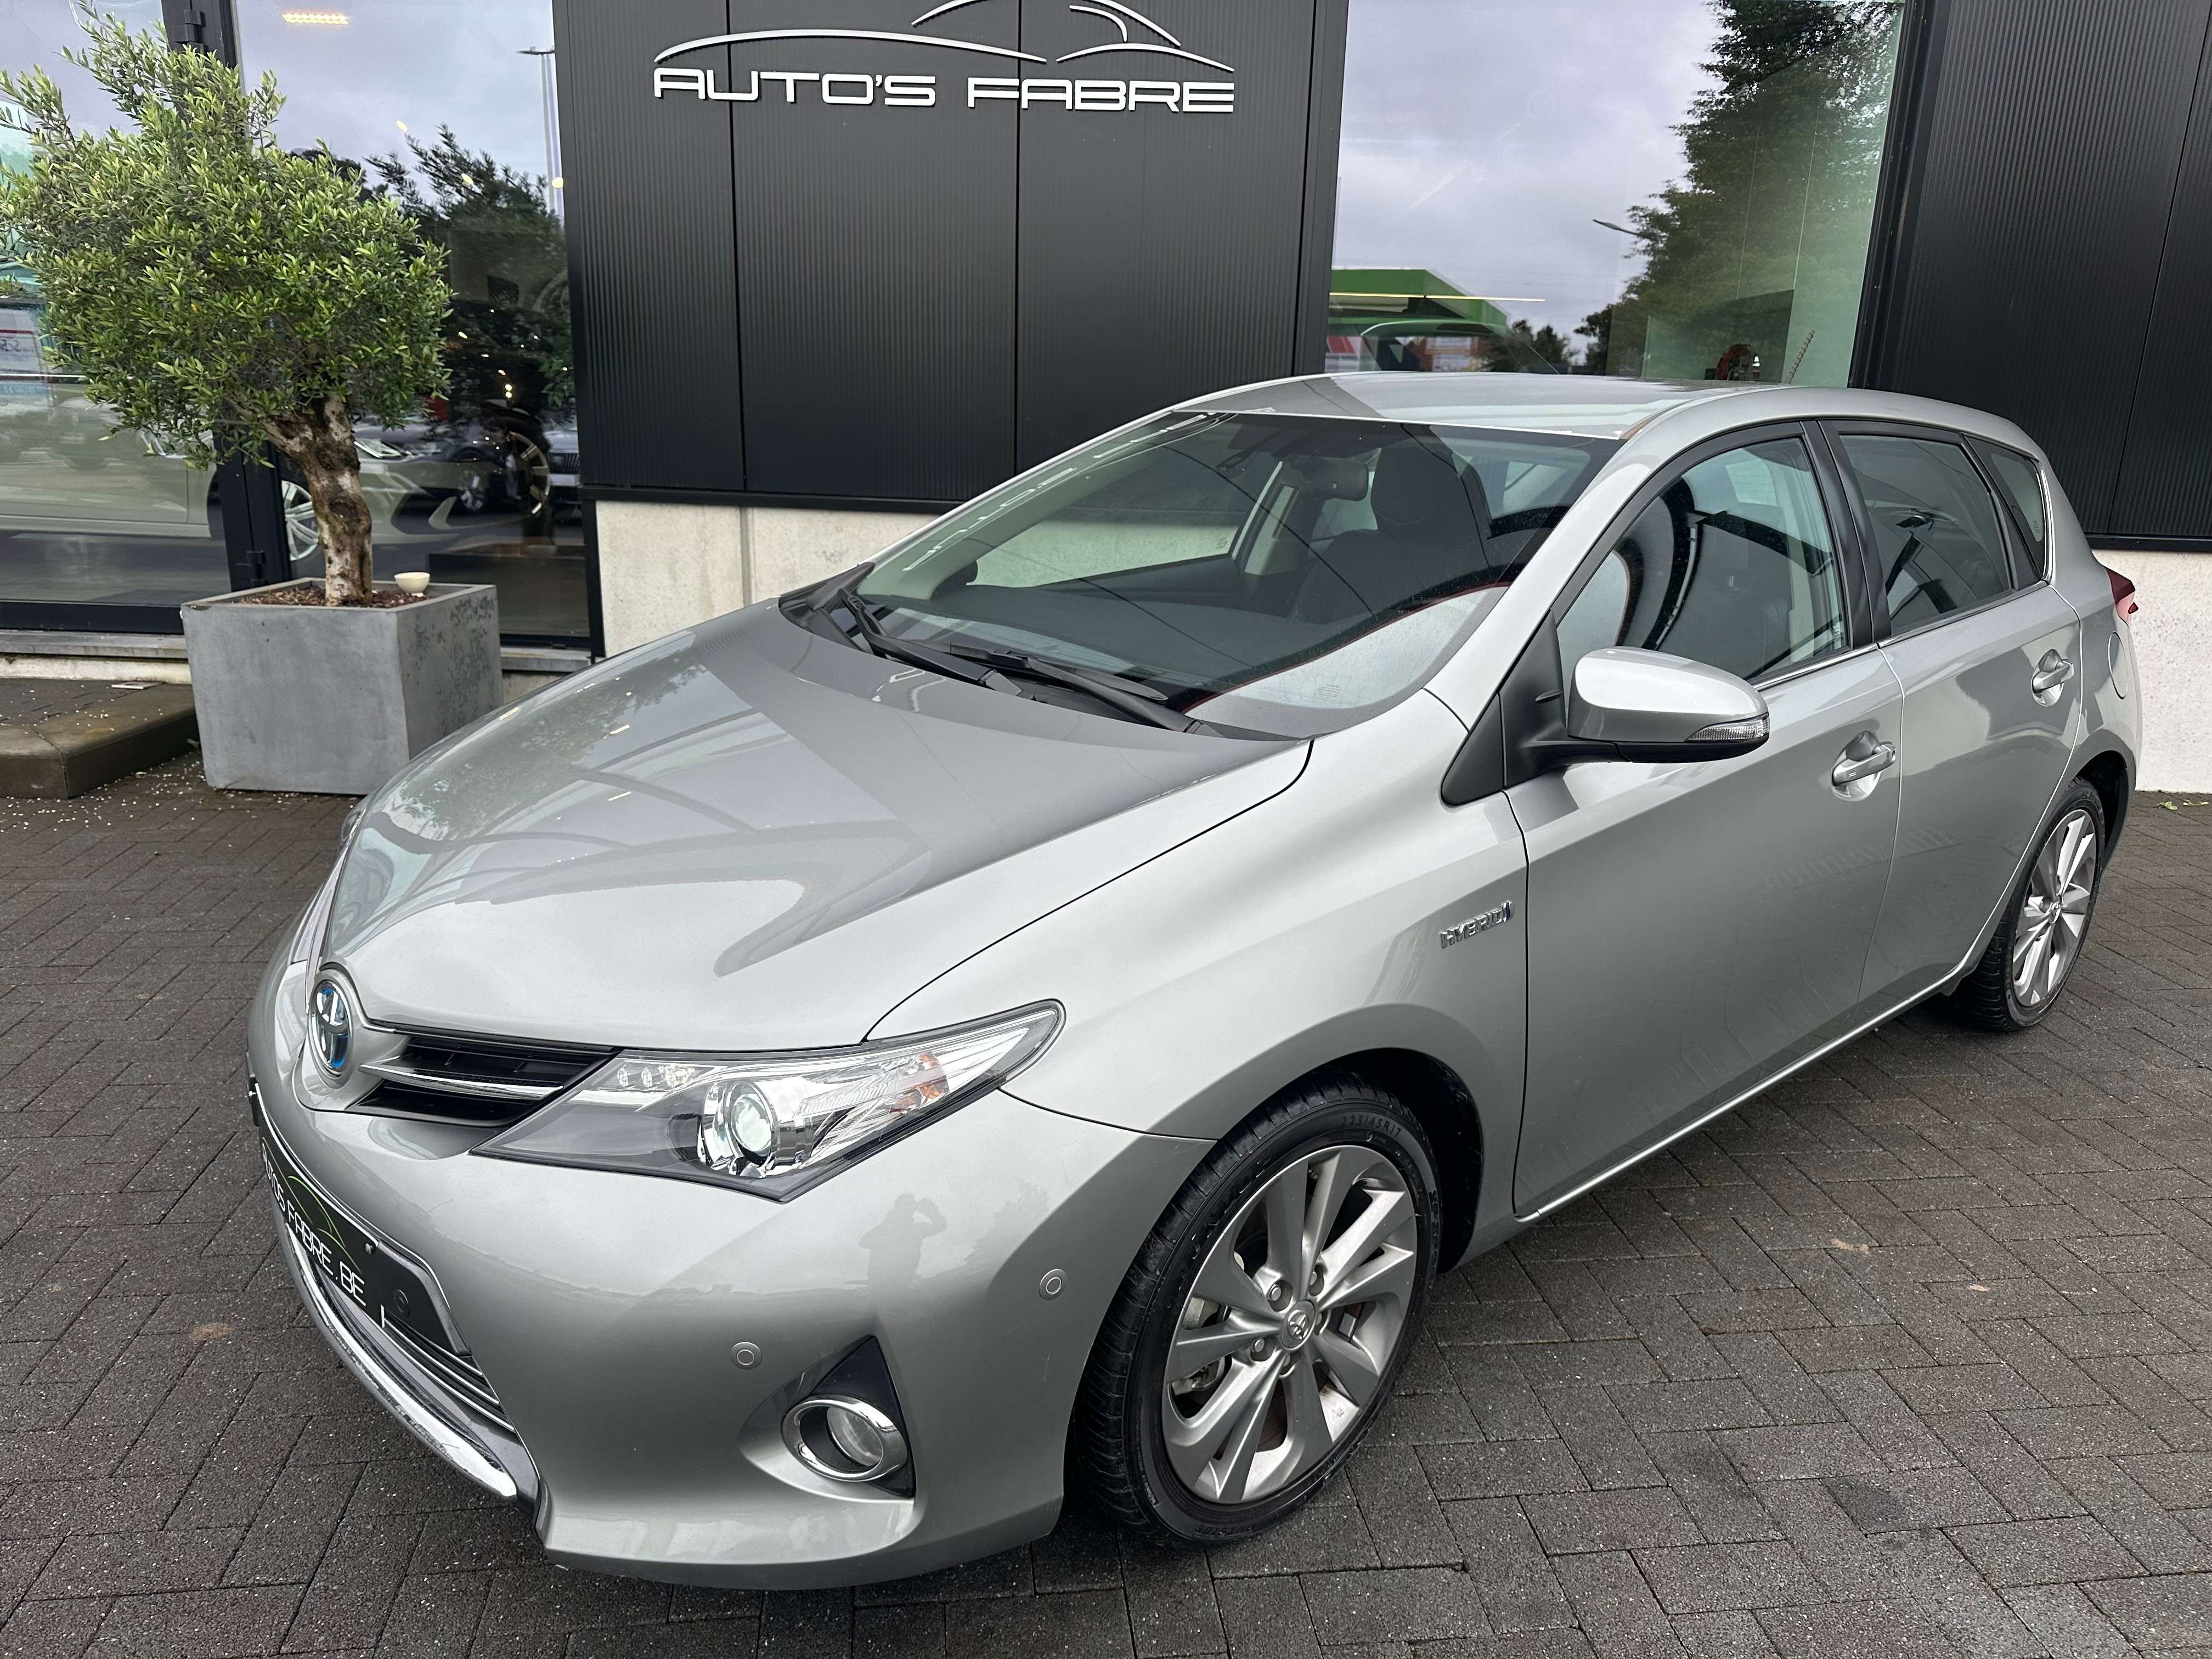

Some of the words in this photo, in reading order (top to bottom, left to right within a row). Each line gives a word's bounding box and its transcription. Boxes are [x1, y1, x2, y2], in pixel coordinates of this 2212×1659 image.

[653, 67, 936, 106] AUTO'S
[968, 77, 1235, 112] FABRE
[1440, 907, 1503, 949] HYBRID
[1342, 1115, 1401, 1137] 225/45R17
